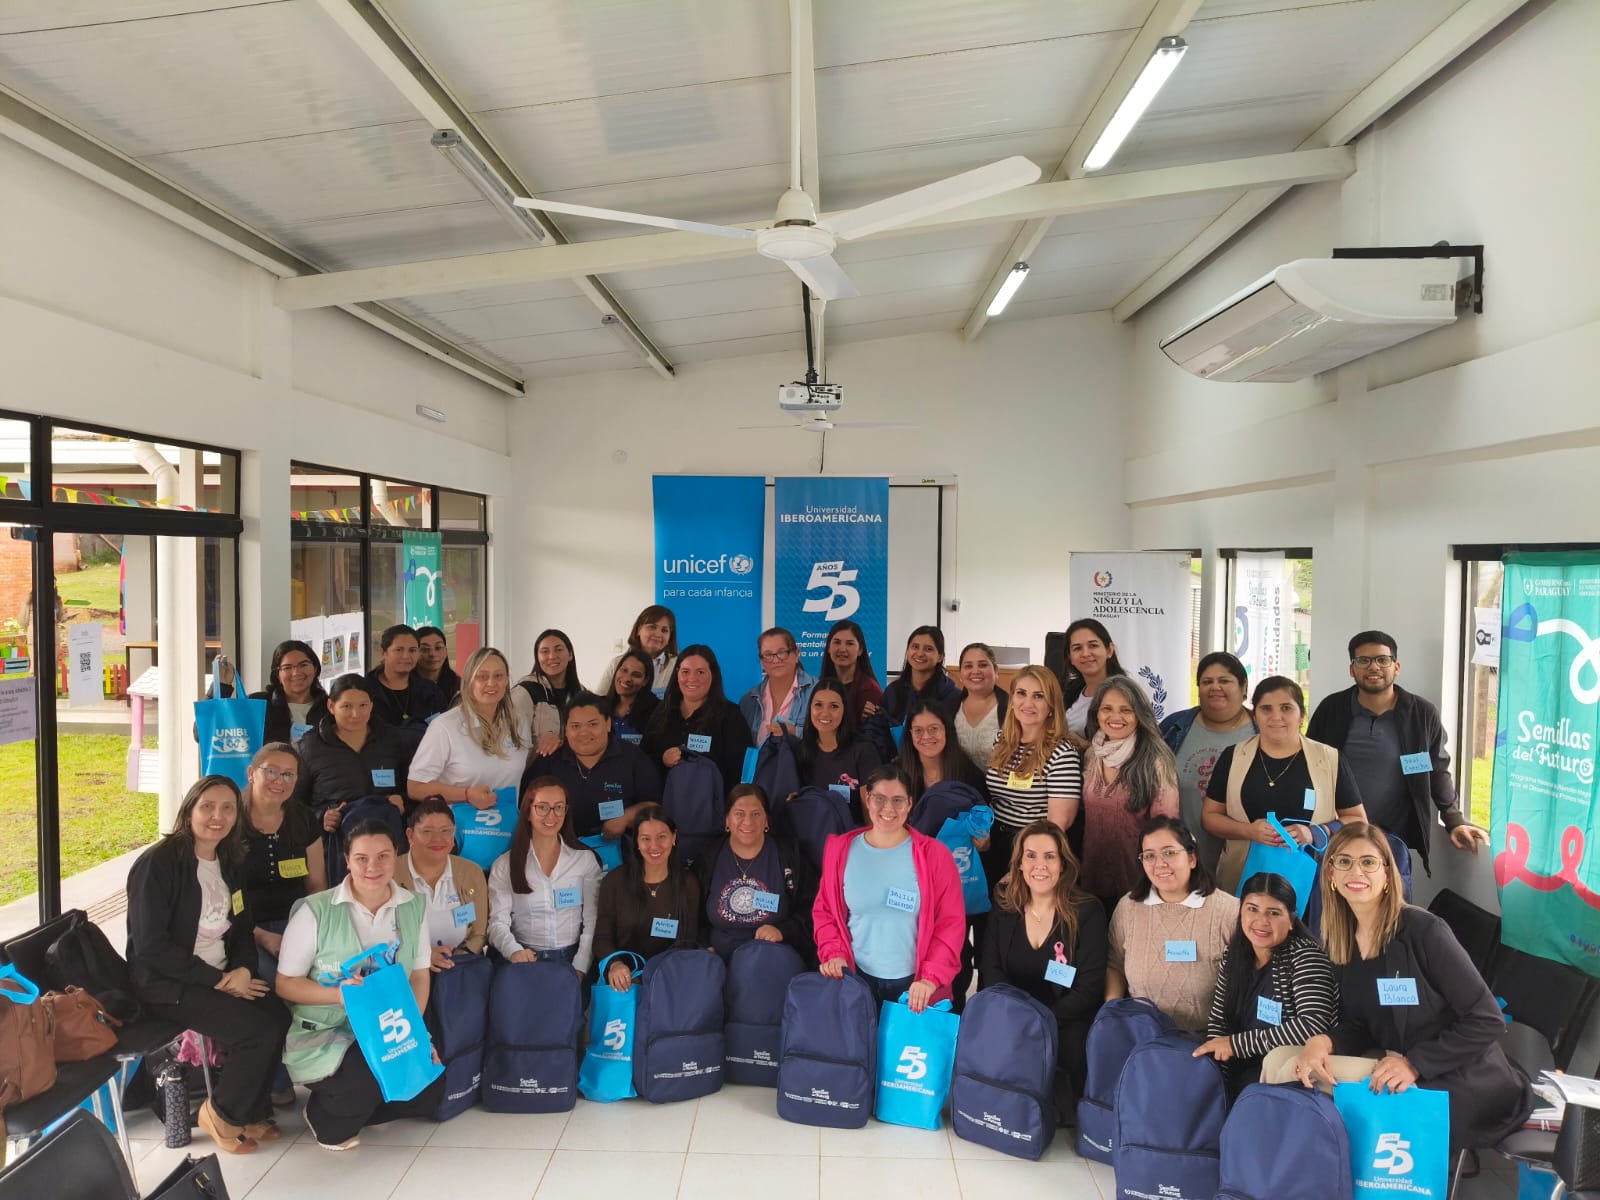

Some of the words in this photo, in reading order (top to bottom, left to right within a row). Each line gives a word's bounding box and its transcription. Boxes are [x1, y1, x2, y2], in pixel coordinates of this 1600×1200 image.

[806, 505, 857, 513] Universidad
[780, 514, 882, 523] IBEROAMERICANA
[663, 553, 727, 574] unicef
[816, 563, 839, 571] AÑOS
[663, 588, 686, 599] para
[688, 587, 712, 597] cada
[715, 587, 753, 598] infancia
[802, 560, 860, 622] 55
[1093, 596, 1122, 605] NIÑEZ
[1131, 598, 1143, 606] LA
[1093, 606, 1165, 615] ADOLESCENCIA
[1517, 710, 1592, 751] Semillas
[1512, 744, 1534, 762] del
[1535, 743, 1594, 784] Futuro
[1383, 983, 1408, 992] Laura
[1384, 993, 1416, 1003] Blanco
[380, 1007, 412, 1044] 55
[603, 1018, 627, 1051] 55
[896, 1045, 928, 1080] 55
[1372, 1132, 1414, 1175] 55
[1356, 1178, 1432, 1196] IBEROAMERICANA
